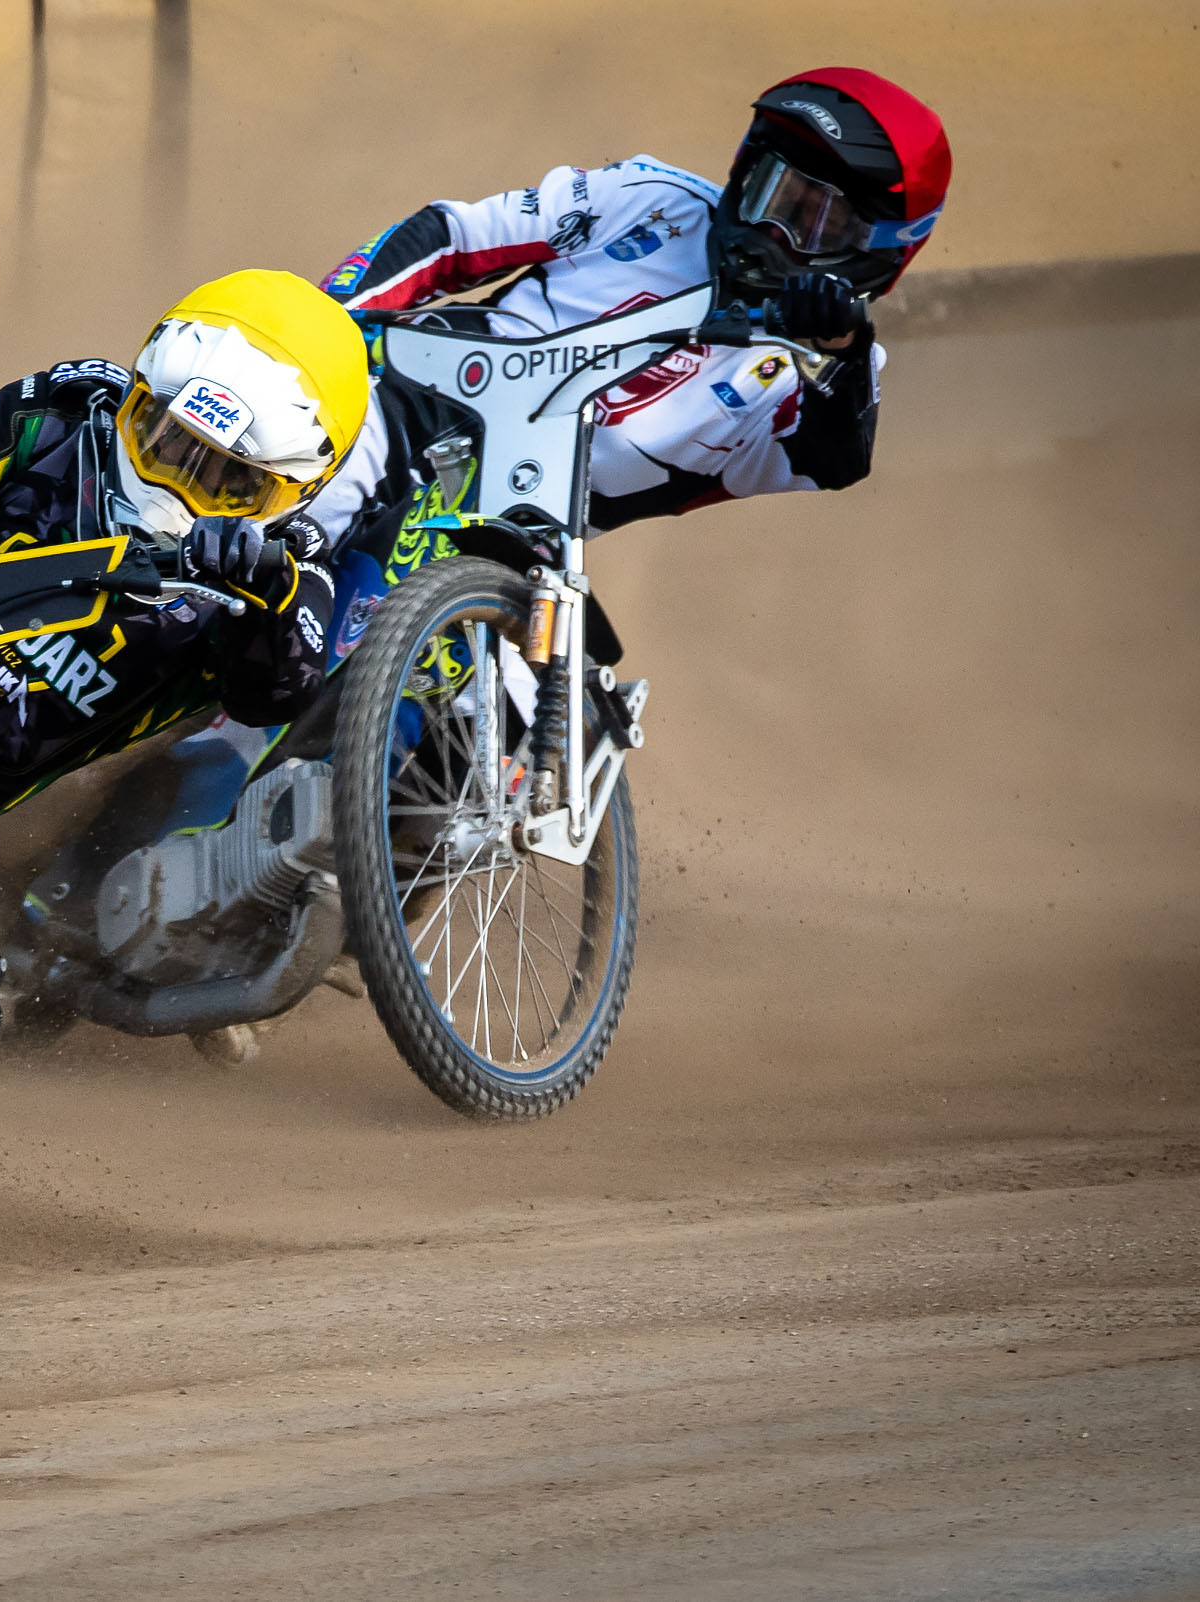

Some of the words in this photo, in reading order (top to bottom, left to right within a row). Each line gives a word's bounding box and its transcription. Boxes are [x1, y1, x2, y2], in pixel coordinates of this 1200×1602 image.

[789, 101, 837, 135] SHOEI
[50, 359, 131, 382] ACD
[503, 343, 623, 380] OPTIBET
[183, 400, 231, 433] MAK
[191, 386, 240, 425] Smak
